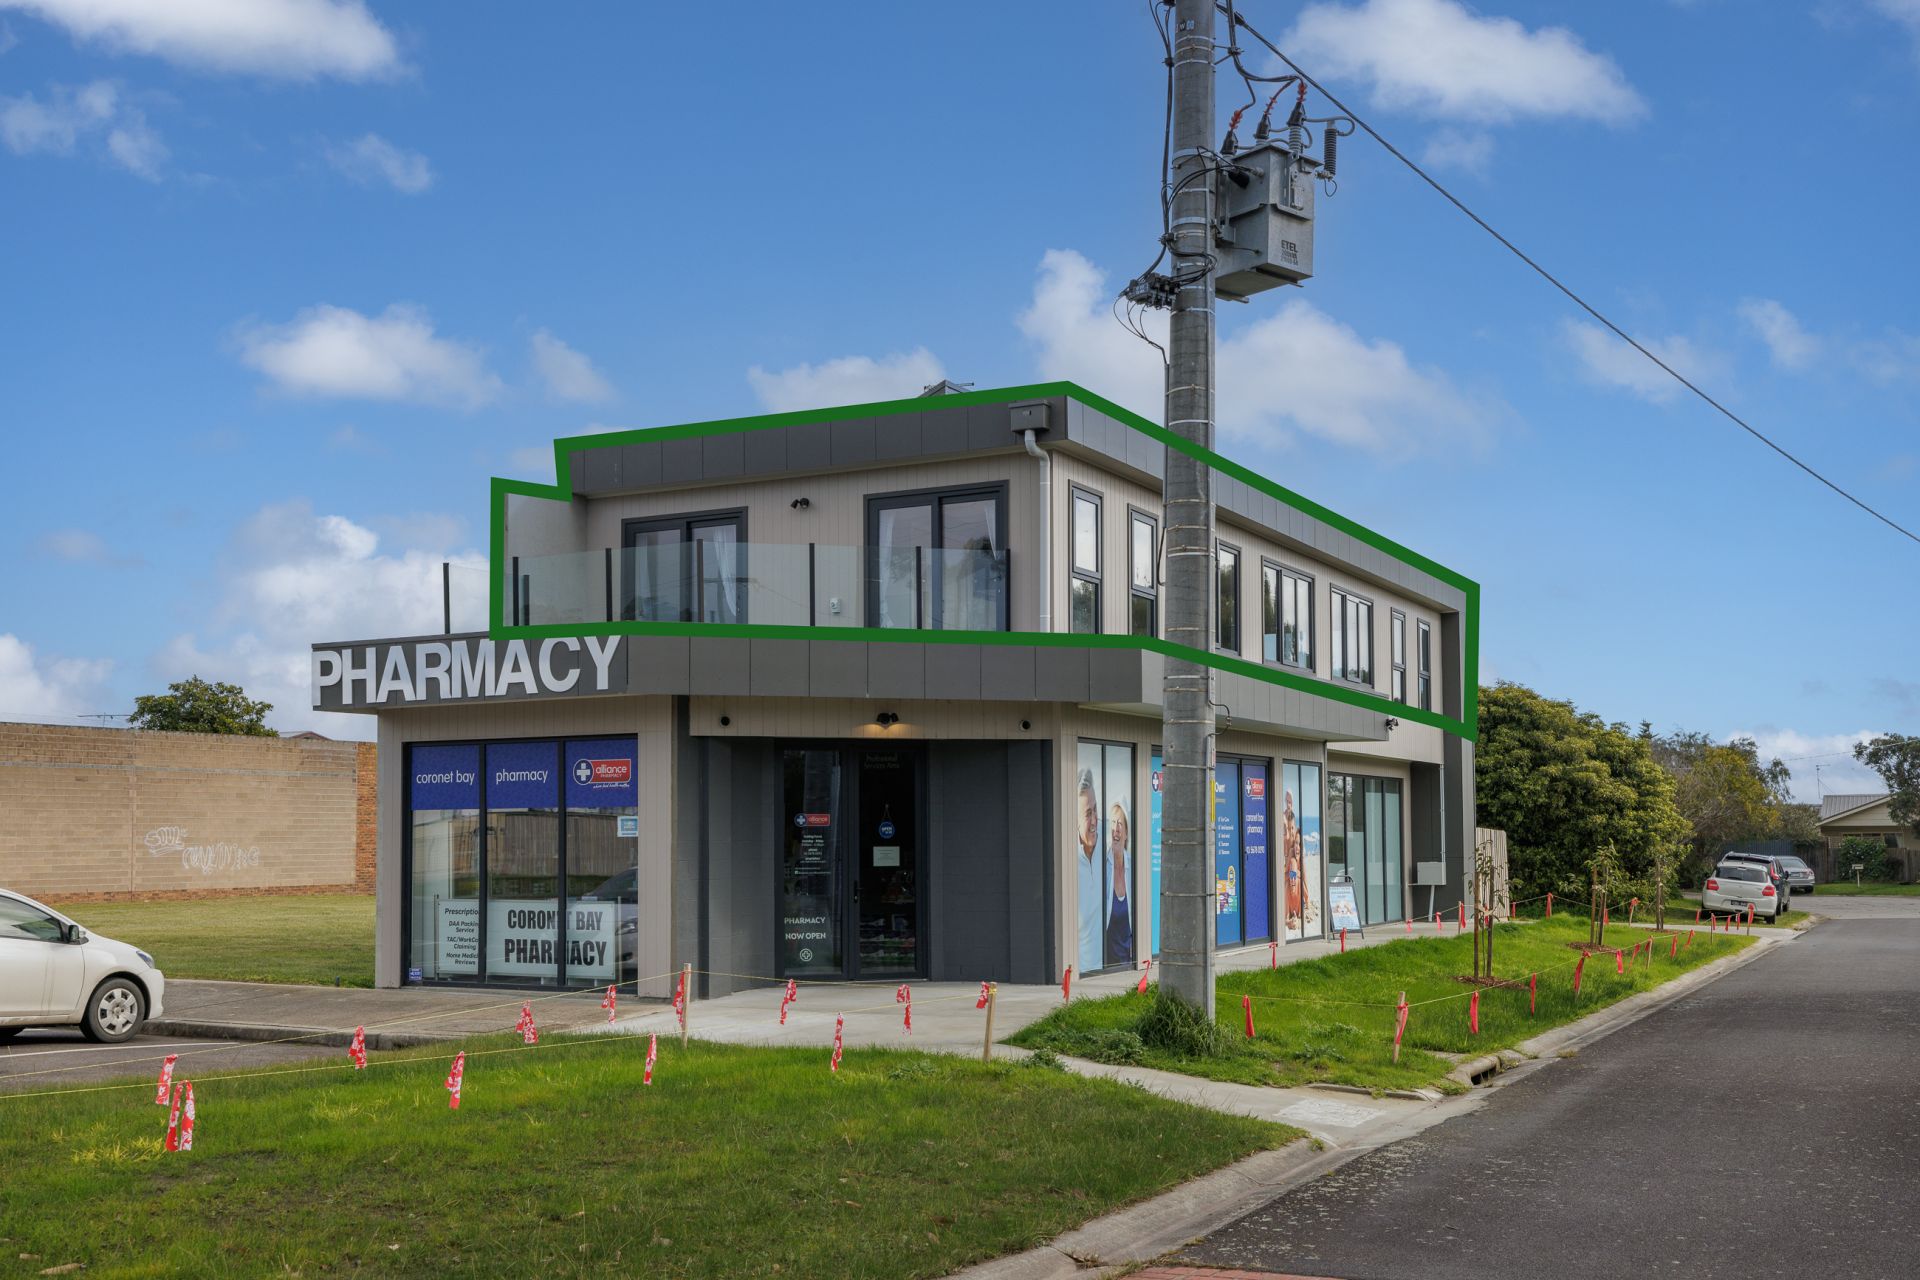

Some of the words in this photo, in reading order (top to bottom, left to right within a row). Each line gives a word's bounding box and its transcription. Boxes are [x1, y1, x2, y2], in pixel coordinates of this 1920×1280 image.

[1281, 239, 1298, 253] ETEL
[312, 634, 622, 706] PHARMACY
[595, 764, 628, 774] alliance
[416, 770, 454, 784] coronet
[456, 770, 476, 785] bay
[496, 769, 548, 785] pharmacy
[445, 908, 480, 917] Prescriptio
[508, 909, 573, 930] CORONT
[576, 911, 603, 931] BAY
[785, 932, 805, 940] NOW
[805, 932, 827, 940] OPEN
